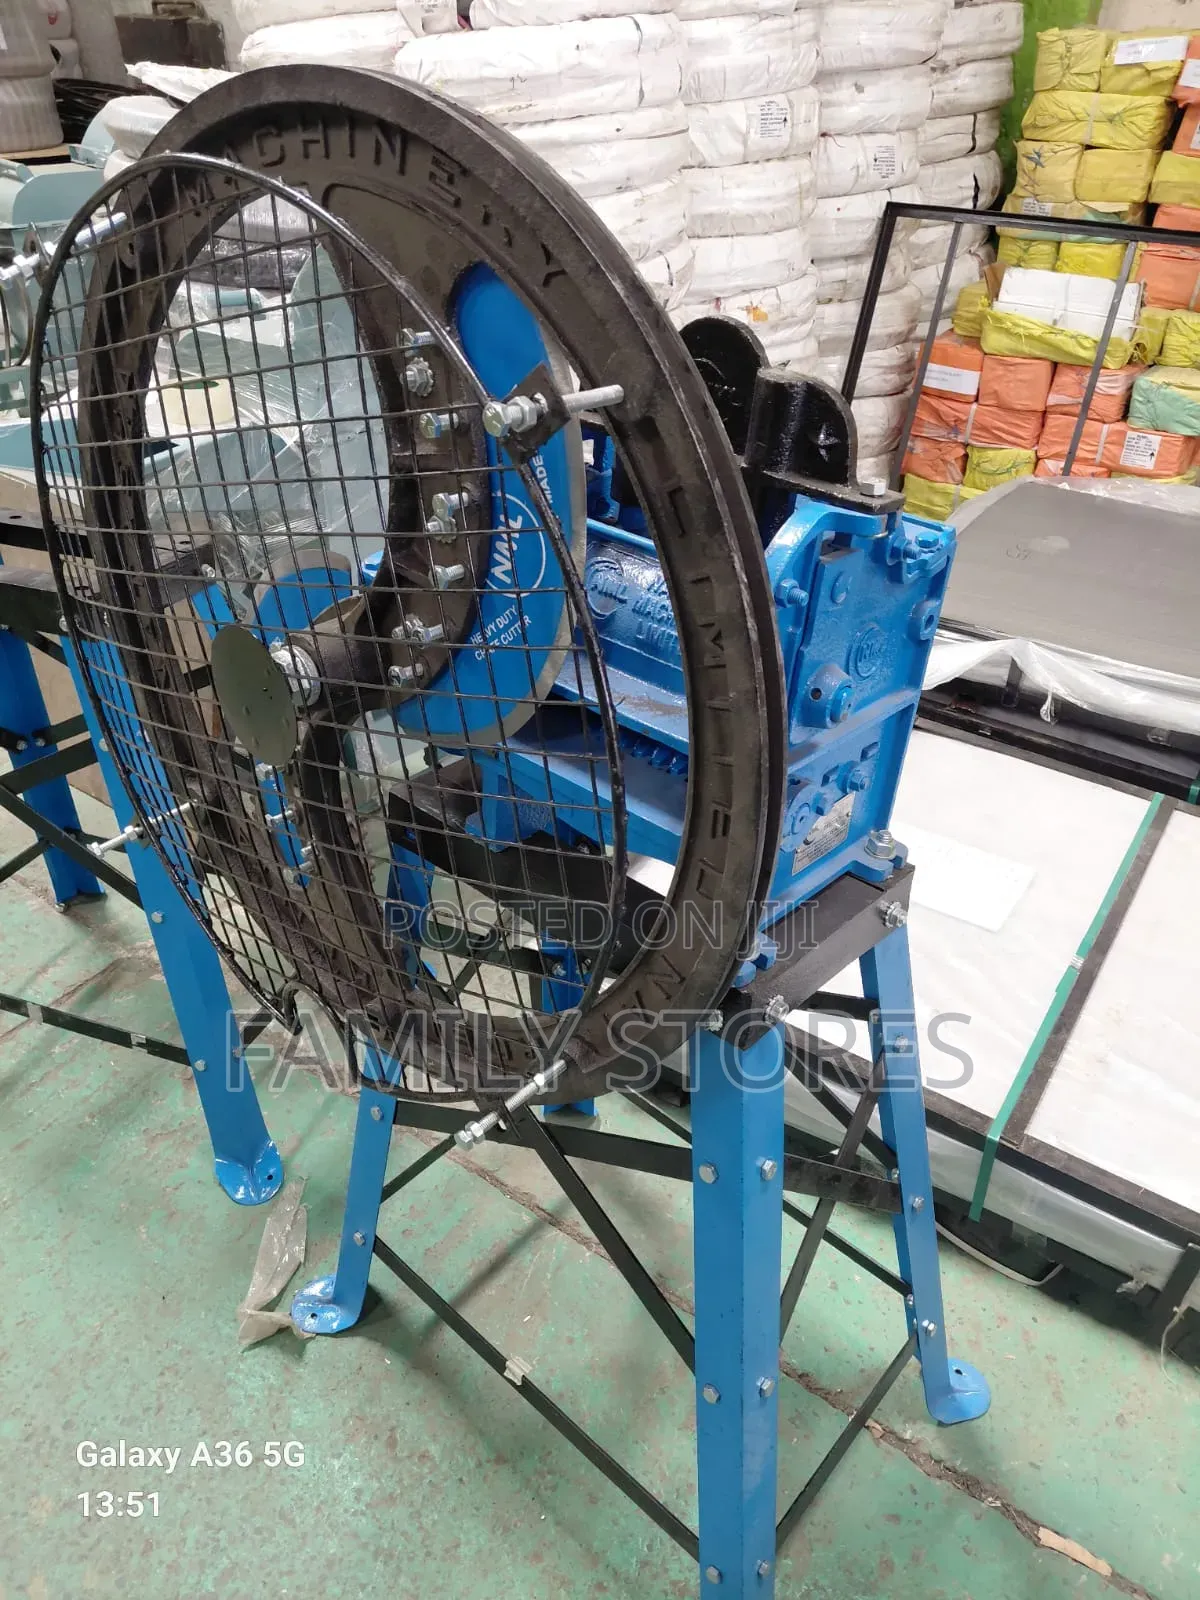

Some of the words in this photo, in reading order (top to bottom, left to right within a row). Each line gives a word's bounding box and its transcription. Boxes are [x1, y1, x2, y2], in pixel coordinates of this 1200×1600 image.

[495, 605, 518, 629] DUTY
[474, 638, 500, 661] CHFF
[500, 615, 532, 645] CUTTR
